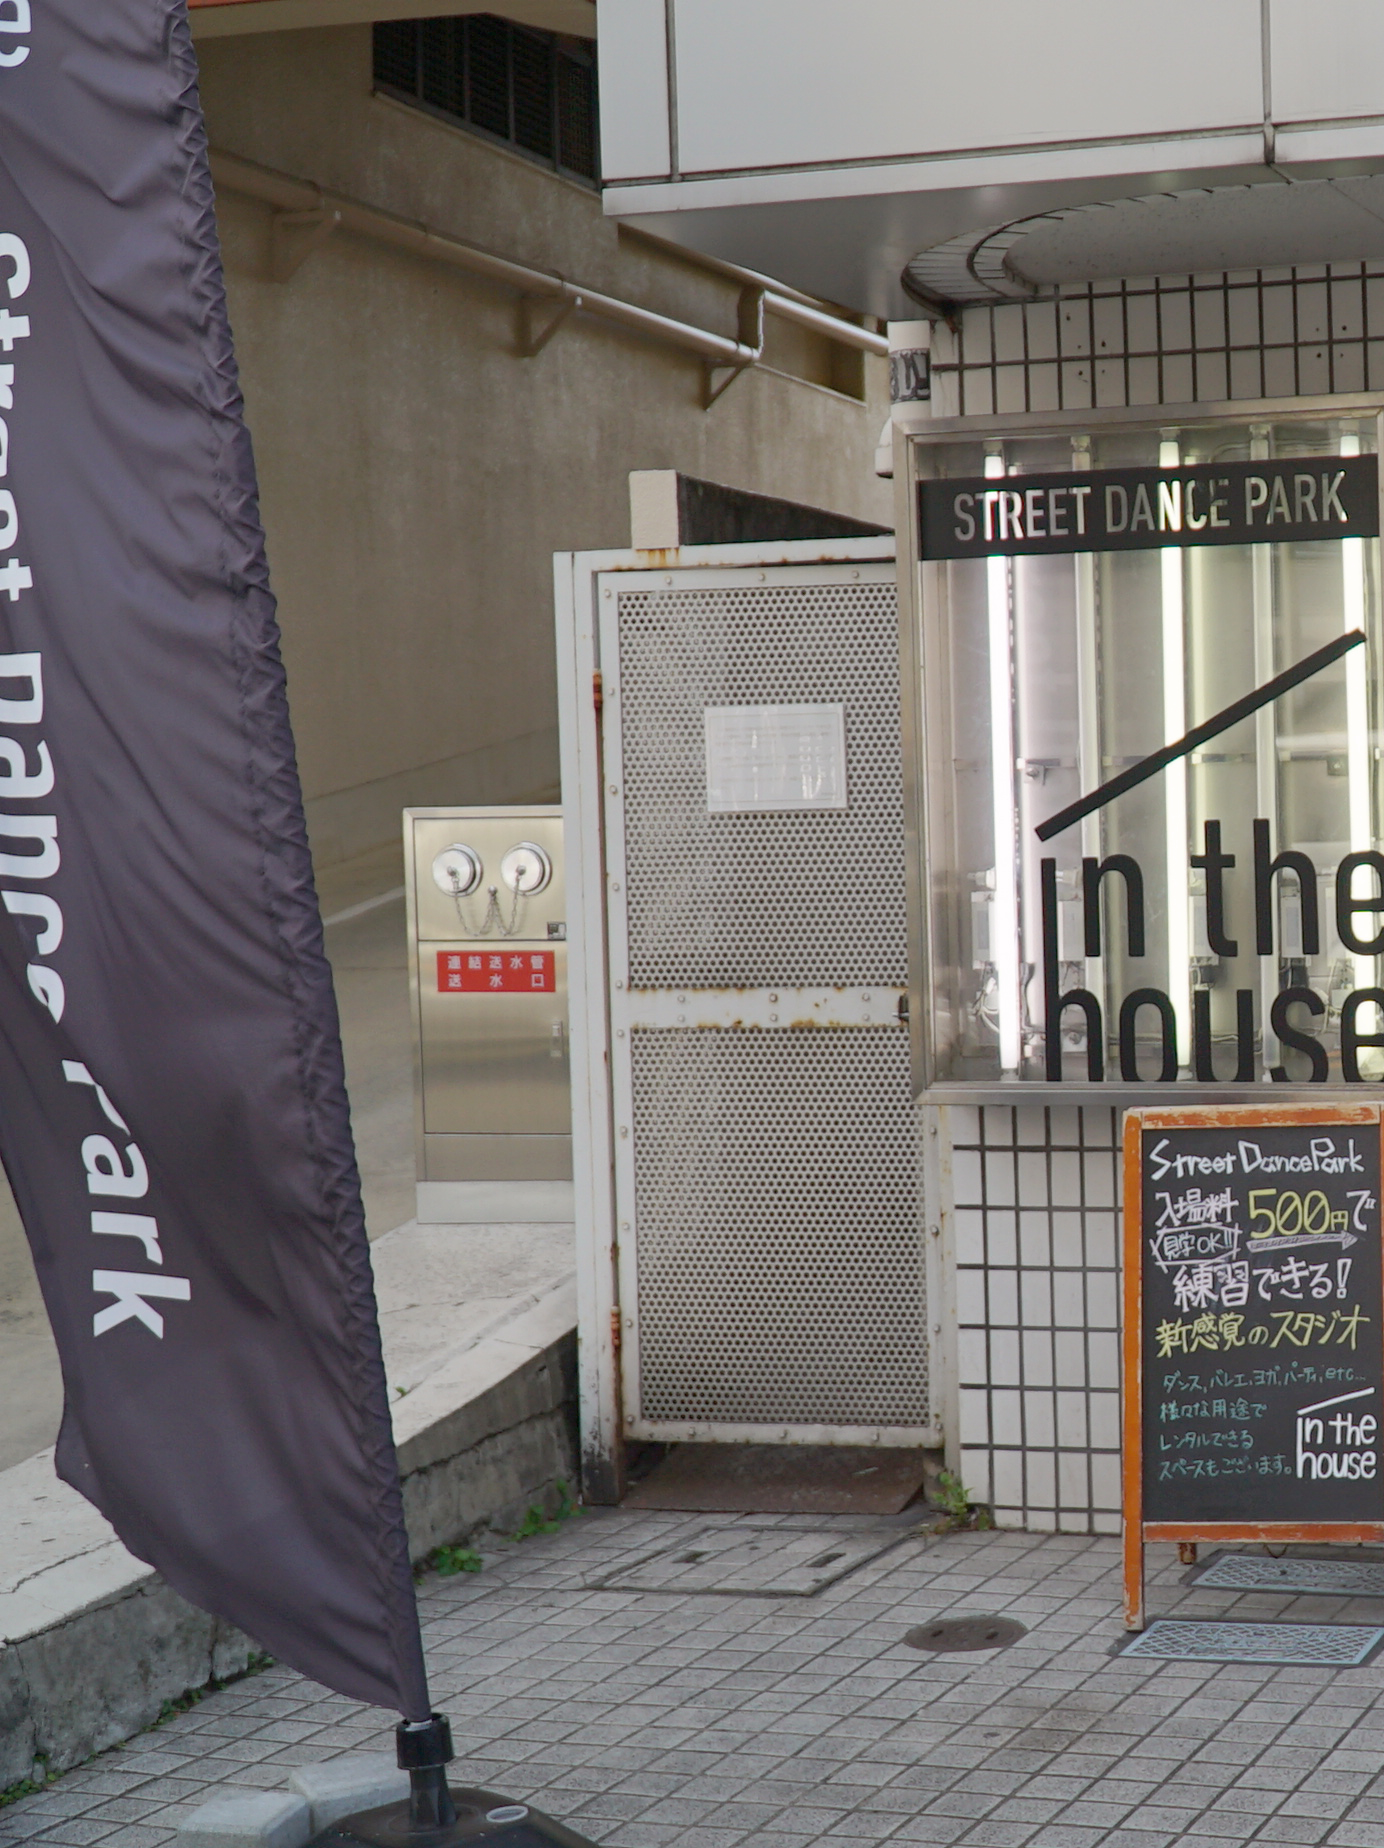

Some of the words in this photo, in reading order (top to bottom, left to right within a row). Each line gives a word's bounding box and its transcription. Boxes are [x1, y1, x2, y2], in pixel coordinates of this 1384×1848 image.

[953, 485, 1092, 542] STREET
[1105, 479, 1231, 534] DANCE
[1244, 470, 1348, 526] PARK
[447, 955, 545, 970] 連結送水管
[447, 973, 545, 988] 送水口
[1155, 1186, 1240, 1228] 入場料
[1155, 1303, 1371, 1358] 新感覚のスタジオ
[1160, 1397, 1268, 1424] 様々な用途で
[1160, 1429, 1254, 1450] レンタルできる
[1328, 1412, 1378, 1446] the
[1296, 1446, 1377, 1480] house
